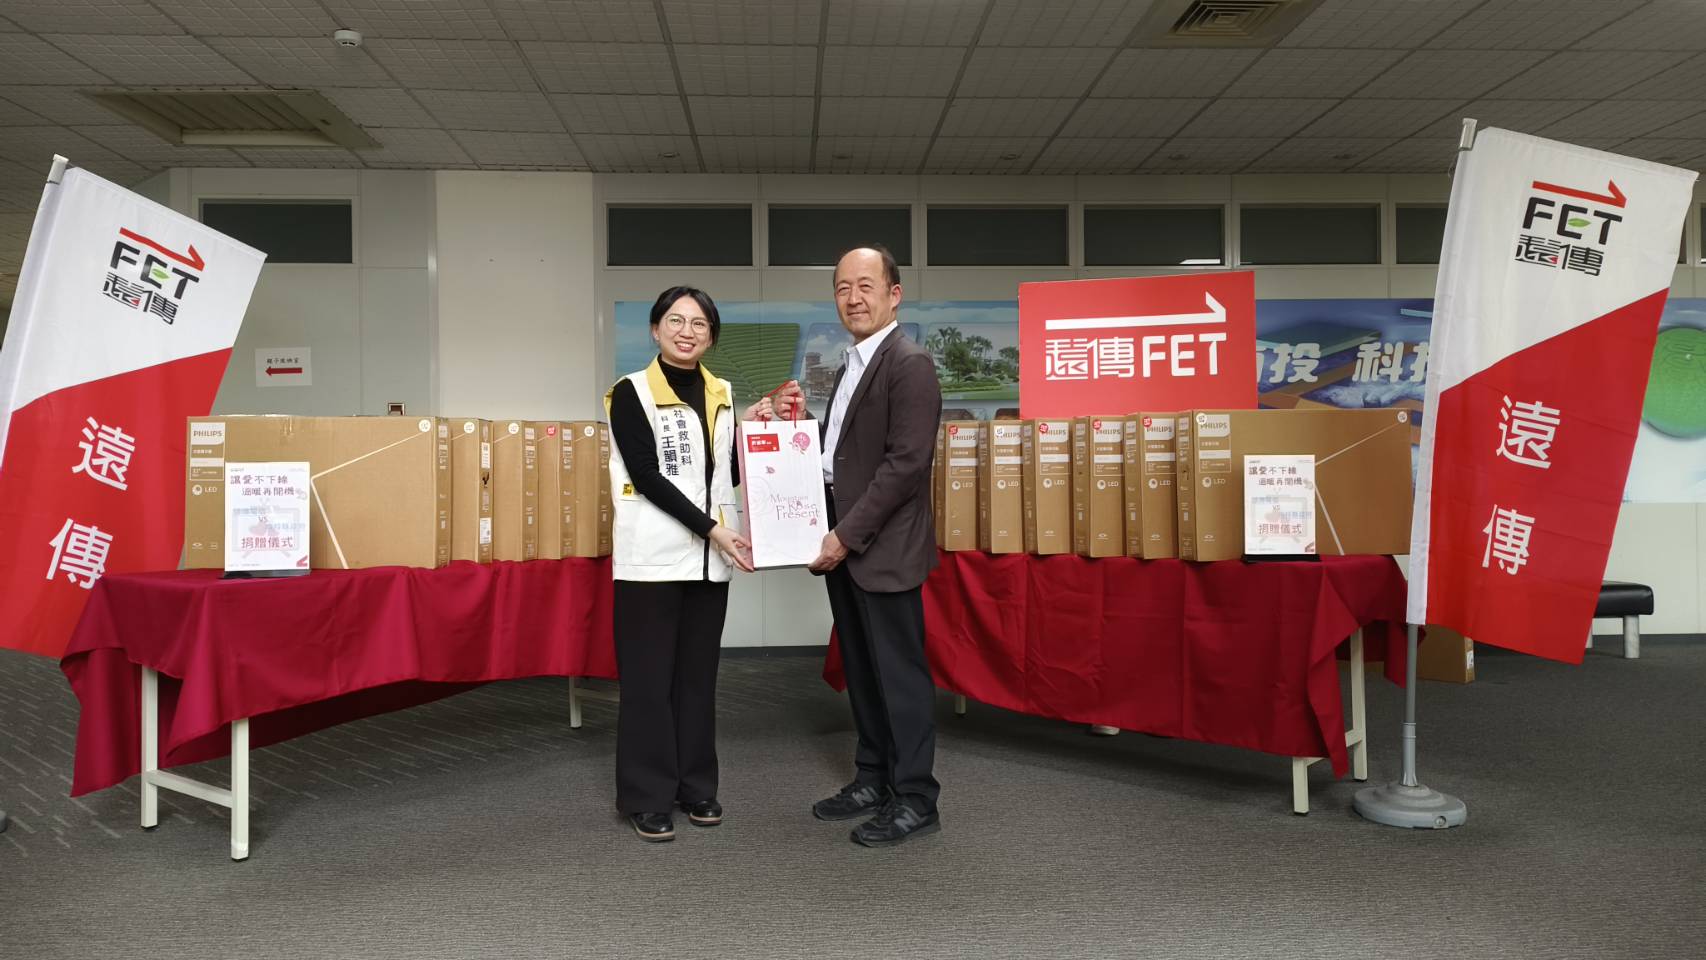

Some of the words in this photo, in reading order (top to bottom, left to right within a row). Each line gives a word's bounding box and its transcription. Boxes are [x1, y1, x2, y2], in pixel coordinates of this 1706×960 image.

[1522, 196, 1622, 245] FET
[110, 240, 200, 300] FET
[1514, 234, 1604, 277] 遠傳
[102, 271, 179, 325] 遠傳
[1045, 336, 1134, 380] 遠傳
[1142, 332, 1227, 378] FET
[661, 415, 671, 432] 科長
[673, 409, 693, 466] 社會救助科
[1200, 422, 1228, 430] PHILIPS
[661, 435, 680, 477] 王韻雅
[230, 475, 288, 485] 讓愛不下線
[1482, 395, 1561, 576] 遠傳
[46, 416, 136, 590] 遠傳
[241, 537, 294, 549] 捐贈儀式
[1258, 523, 1303, 535] 捐贈儀式
